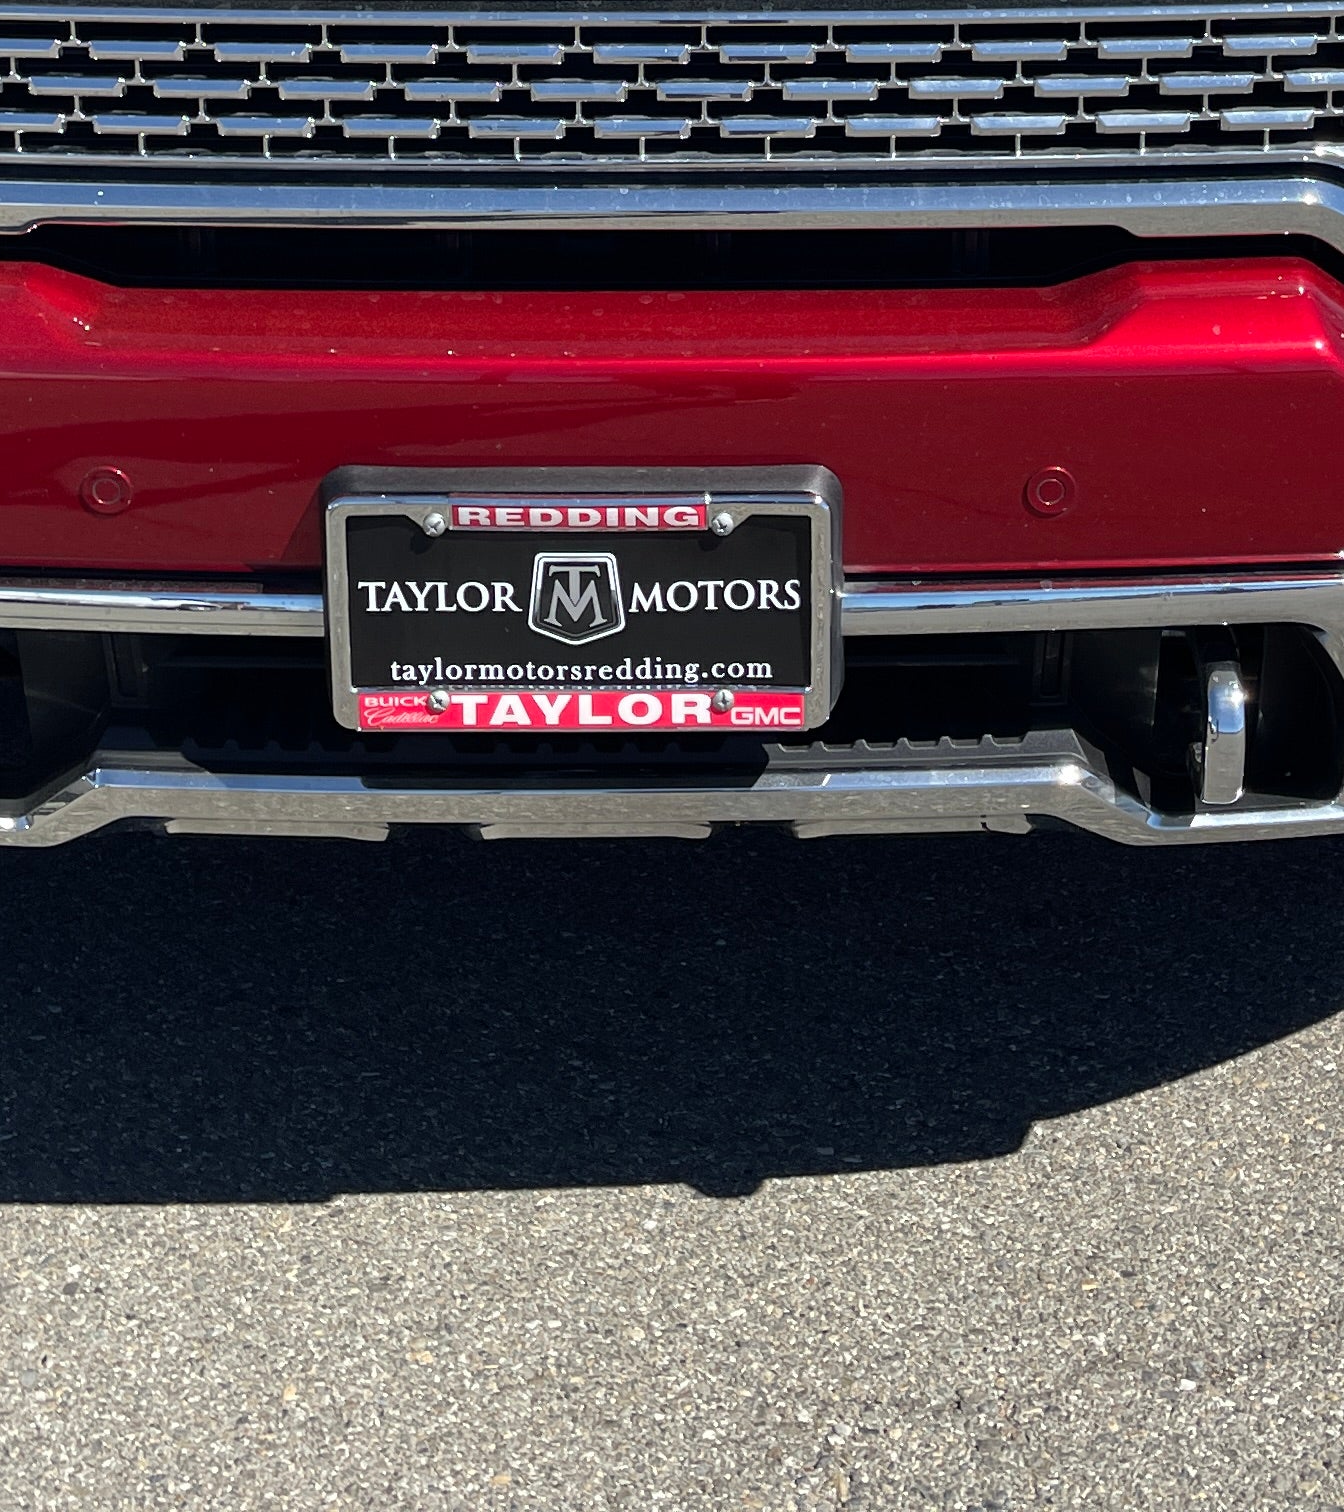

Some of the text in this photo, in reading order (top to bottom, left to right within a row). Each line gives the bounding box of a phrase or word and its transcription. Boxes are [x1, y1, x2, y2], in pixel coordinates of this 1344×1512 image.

[456, 506, 700, 528] REDDING
[357, 580, 523, 613] TAYLOR
[628, 579, 801, 613] MOTORS
[390, 656, 774, 686] taylormotorsredding.com
[363, 696, 428, 708] BUICK
[450, 692, 802, 726] TAYLOR GMC
